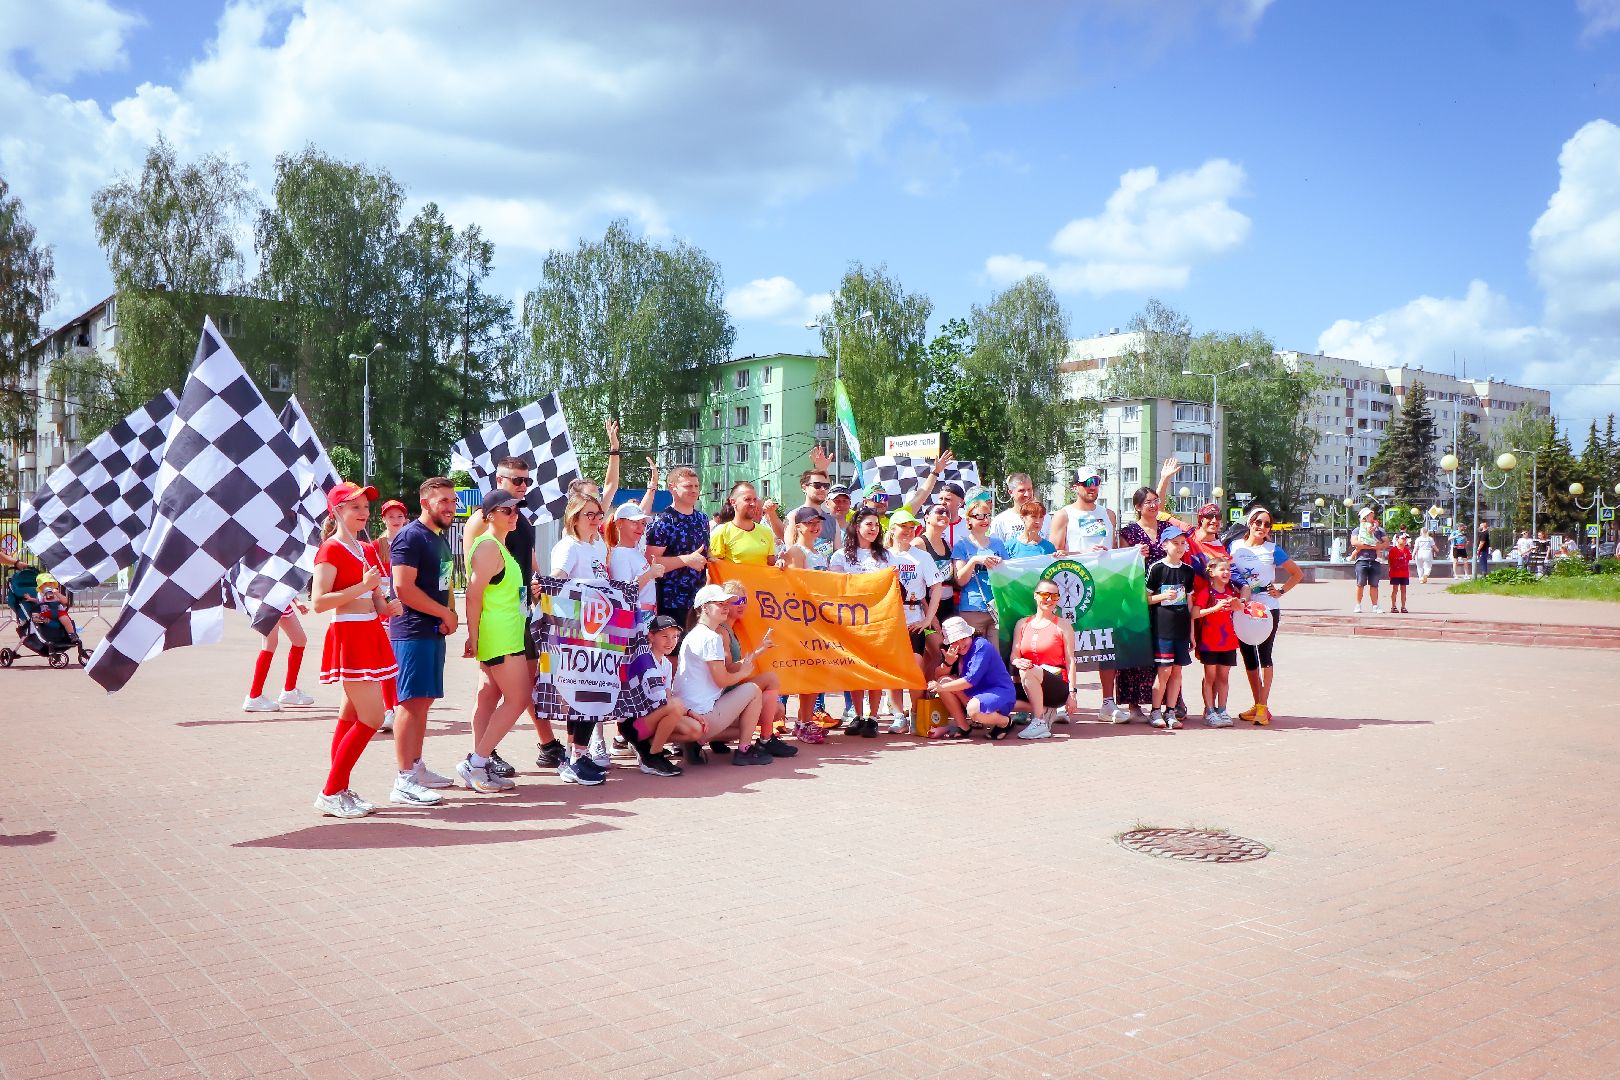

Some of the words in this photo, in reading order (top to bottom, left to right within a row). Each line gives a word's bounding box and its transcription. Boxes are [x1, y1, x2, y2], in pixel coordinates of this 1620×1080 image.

[1073, 627, 1115, 652] ИН
[560, 647, 624, 677] ПОИСК
[1090, 653, 1116, 663] TEAM
